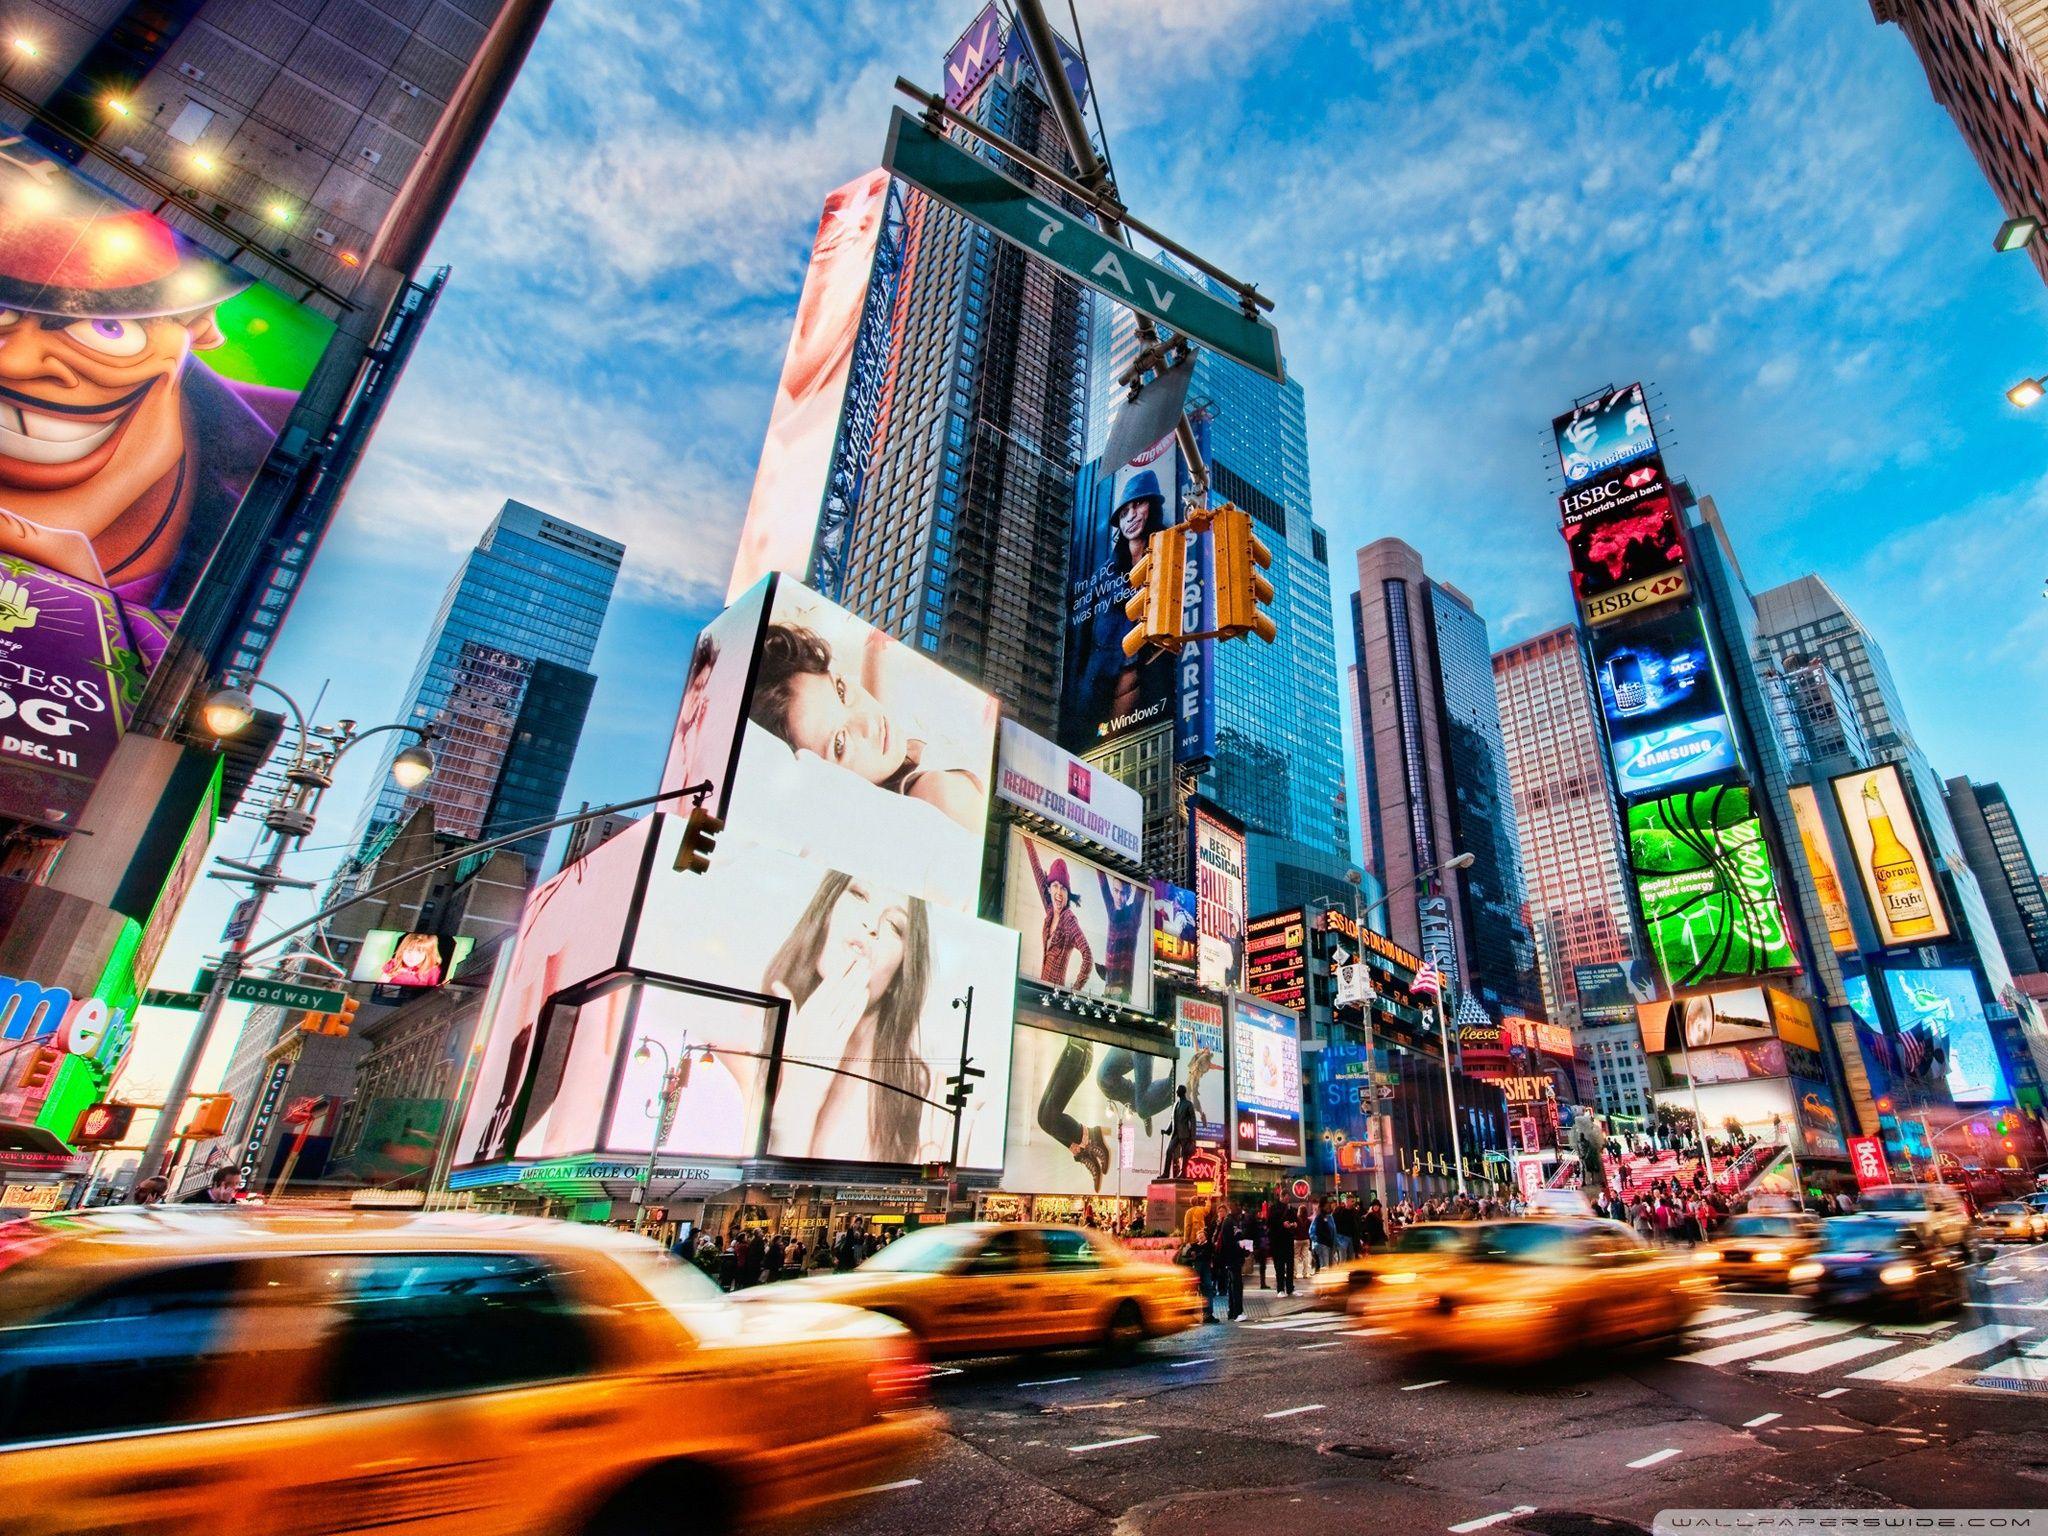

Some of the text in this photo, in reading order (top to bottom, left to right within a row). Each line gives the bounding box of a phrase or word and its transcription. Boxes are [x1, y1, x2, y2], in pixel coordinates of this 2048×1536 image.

[1027, 203, 1064, 247] 7
[1588, 438, 1654, 471] Prudential
[1562, 480, 1622, 515] HSBC
[1566, 482, 1663, 524] The world's local bank
[1073, 572, 1131, 611] and Windo
[1074, 561, 1115, 595] I'm a PC
[1072, 608, 1092, 626] was
[1094, 597, 1112, 614] my
[1587, 586, 1649, 618] HSBC
[1181, 559, 1202, 719] SQUARE
[1111, 698, 1167, 731] Windows 7
[2, 735, 78, 768] DEC. 11
[1182, 735, 1199, 747] NYC
[1637, 739, 1713, 769] SAMSUNG
[1072, 772, 1087, 791] GAP
[1003, 769, 1139, 853] READY FOR HOLIDAY CHEER
[1200, 847, 1241, 879] MUSICAL
[1209, 837, 1232, 861] BEST
[1201, 865, 1228, 909] BILLY
[1640, 870, 1714, 892] display powered
[1876, 867, 1916, 881] Corona
[1645, 882, 1714, 902] by wind energy
[1888, 895, 1922, 910] Light
[1201, 900, 1234, 943] ELLIOT
[1248, 912, 1301, 932] THOMSON REUTERS
[1248, 940, 1265, 951] STOCK
[164, 993, 177, 1006] 7
[236, 984, 323, 1009] roadway
[1182, 999, 1222, 1027] HEIGHTS
[1179, 1030, 1194, 1048] BEST
[1459, 1026, 1500, 1040] Reese's
[236, 1067, 287, 1190] SCIENTOLOG
[0, 1152, 18, 1160] NEW
[46, 1154, 88, 1162] MARQUIS
[1400, 1147, 1448, 1176] 1585
[1856, 1141, 1879, 1178] tkts
[522, 1167, 573, 1180] AMERICAN
[576, 1165, 620, 1178] EAGLE
